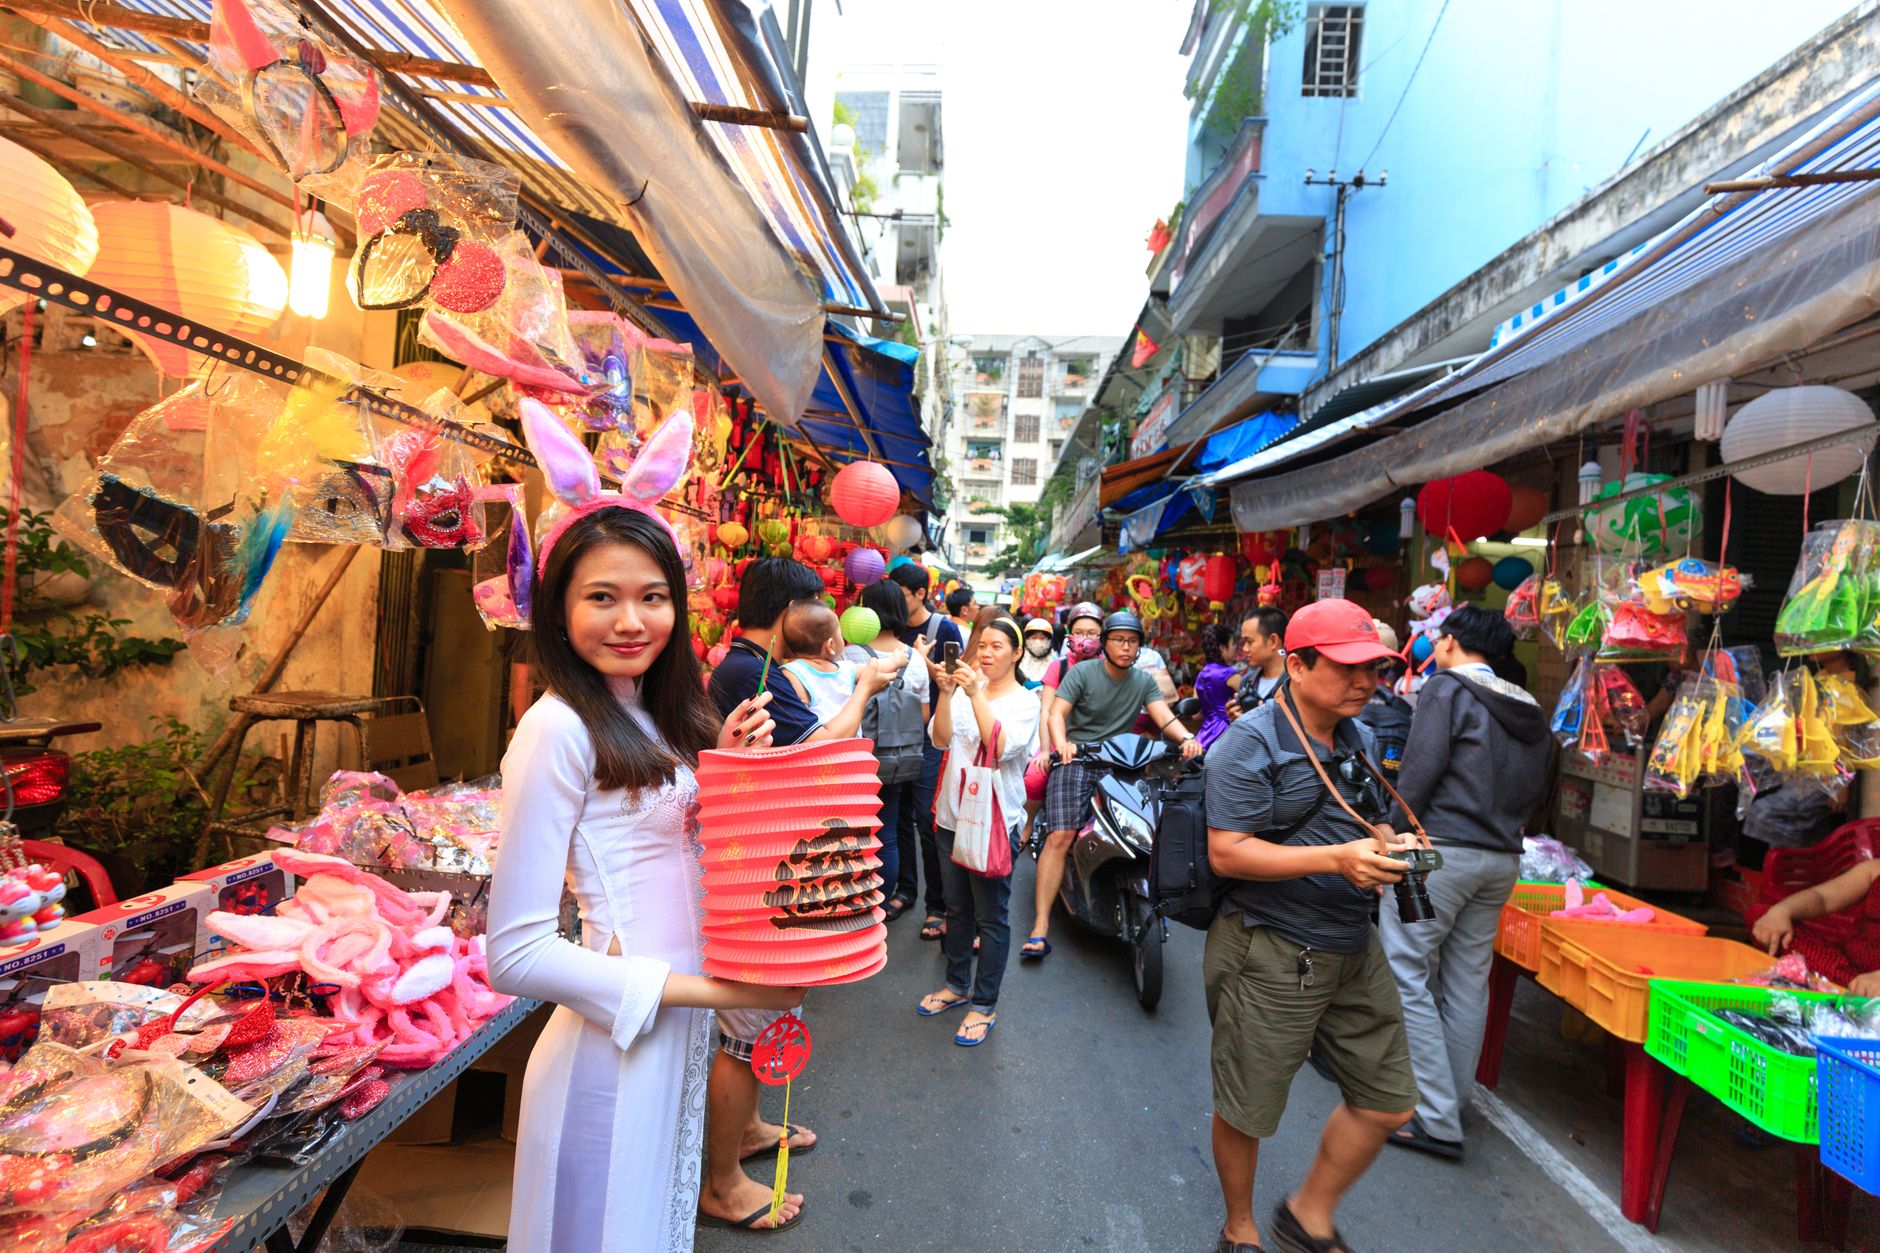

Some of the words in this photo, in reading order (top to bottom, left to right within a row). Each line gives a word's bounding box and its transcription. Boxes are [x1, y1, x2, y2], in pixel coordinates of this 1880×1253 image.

[236, 867, 264, 879] NO.8251
[140, 906, 173, 922] NO.8251
[3, 950, 48, 971] NO.8251
